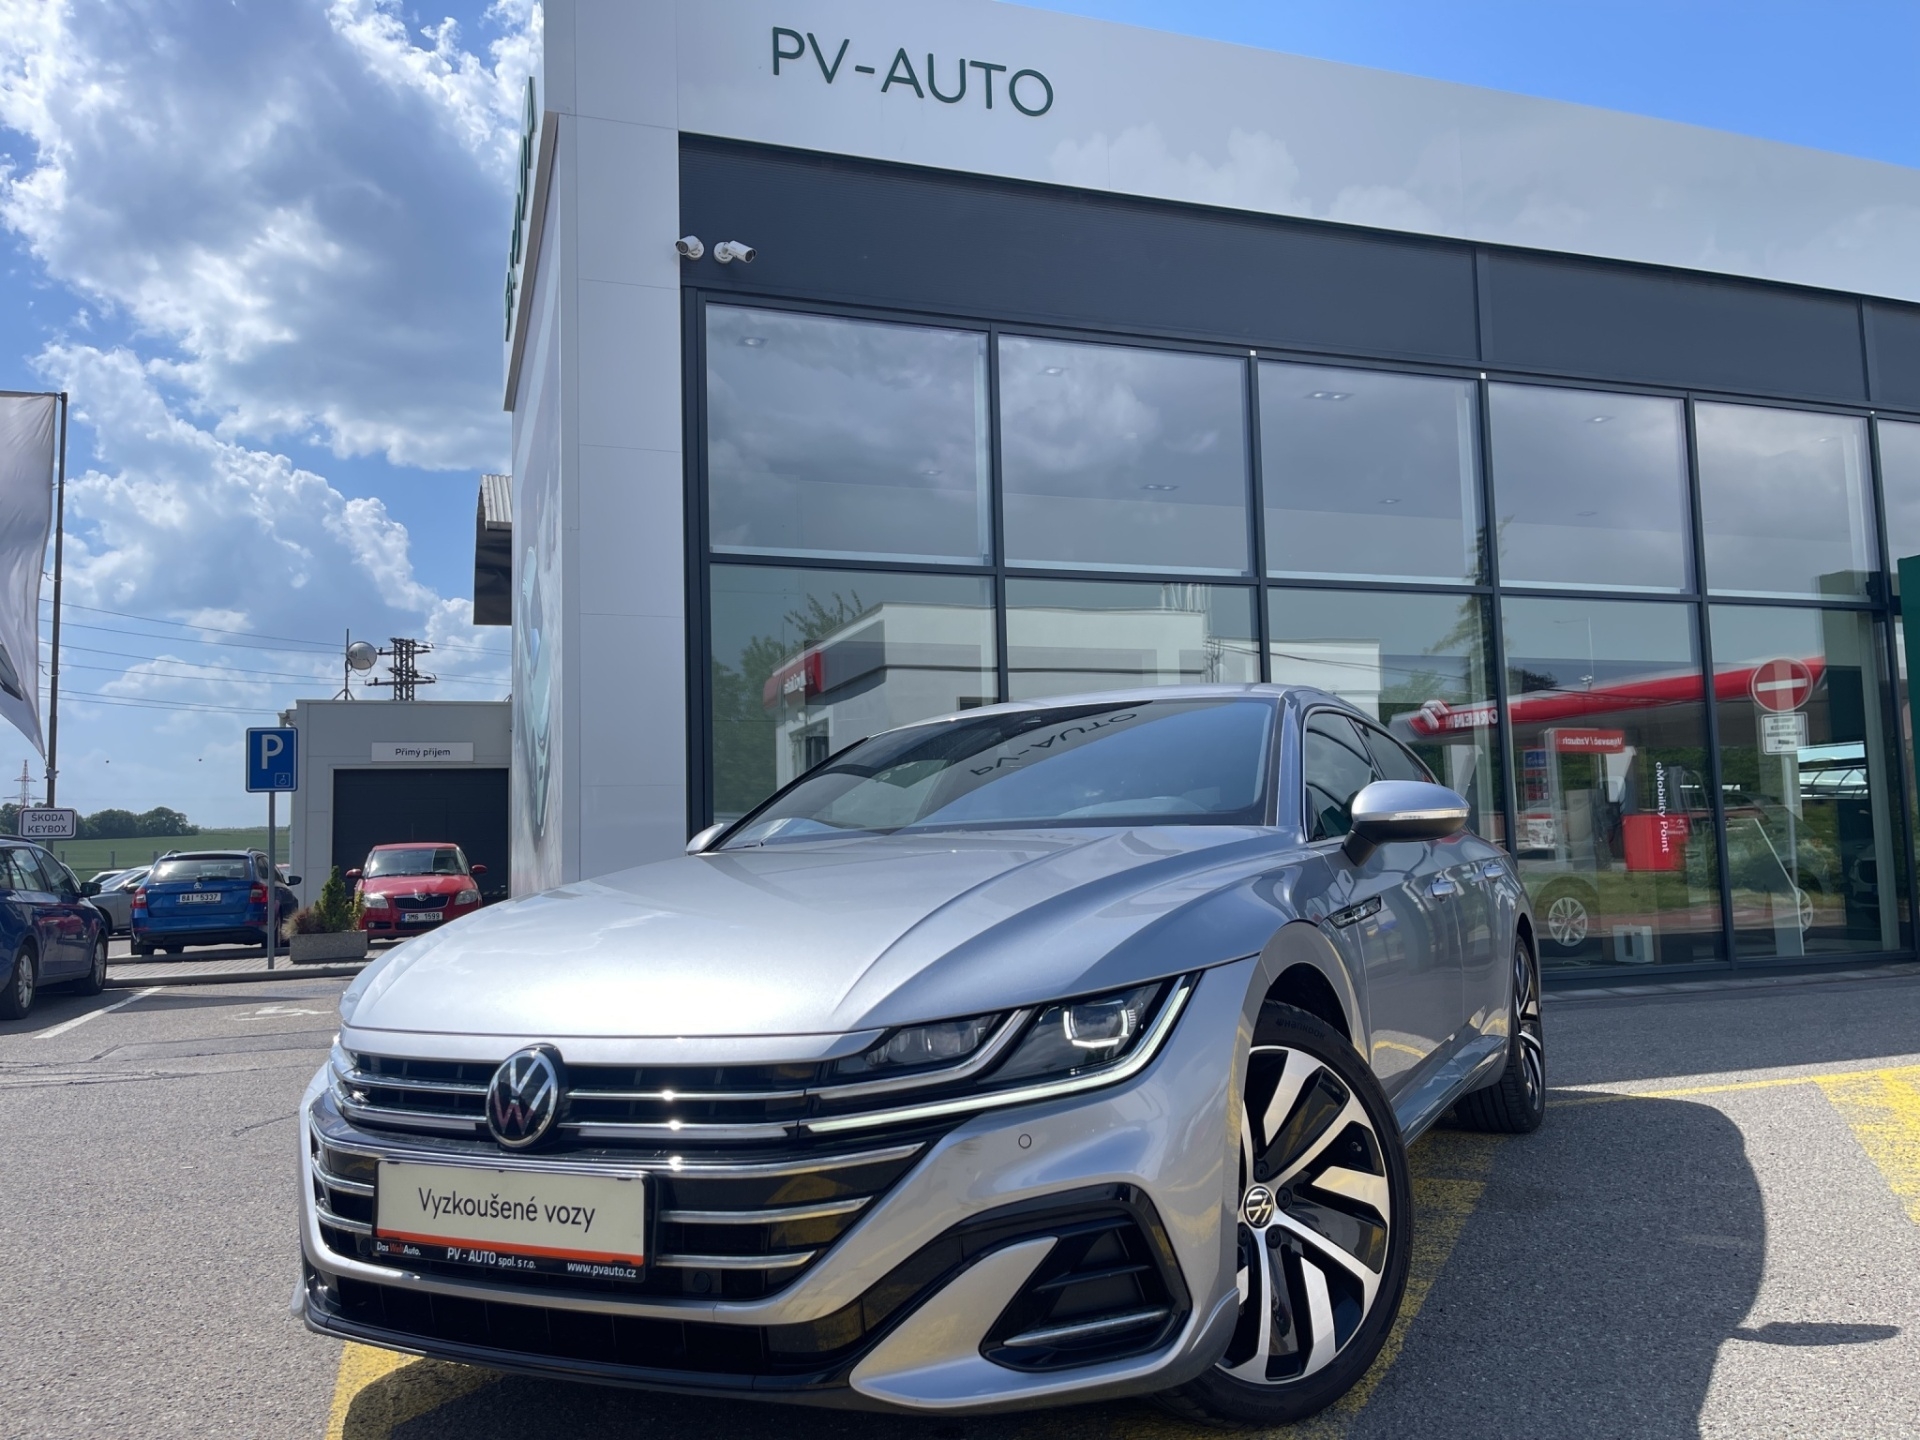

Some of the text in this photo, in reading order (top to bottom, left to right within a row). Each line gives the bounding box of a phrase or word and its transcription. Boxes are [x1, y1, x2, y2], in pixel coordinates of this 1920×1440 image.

[771, 26, 1055, 118] PV-AUTO
[261, 734, 284, 770] P
[395, 747, 451, 758] Přímý příjem
[1655, 761, 1670, 853] eMobility Point
[31, 812, 65, 822] ŠKODA
[27, 824, 67, 834] KEYBOX
[418, 1186, 596, 1233] Vyzkoušené vozy
[376, 1241, 389, 1252] Das
[447, 1246, 461, 1260] PV
[468, 1249, 497, 1265] AUTO
[498, 1255, 516, 1268] spol.
[567, 1262, 637, 1278] www.pvauto.cz
